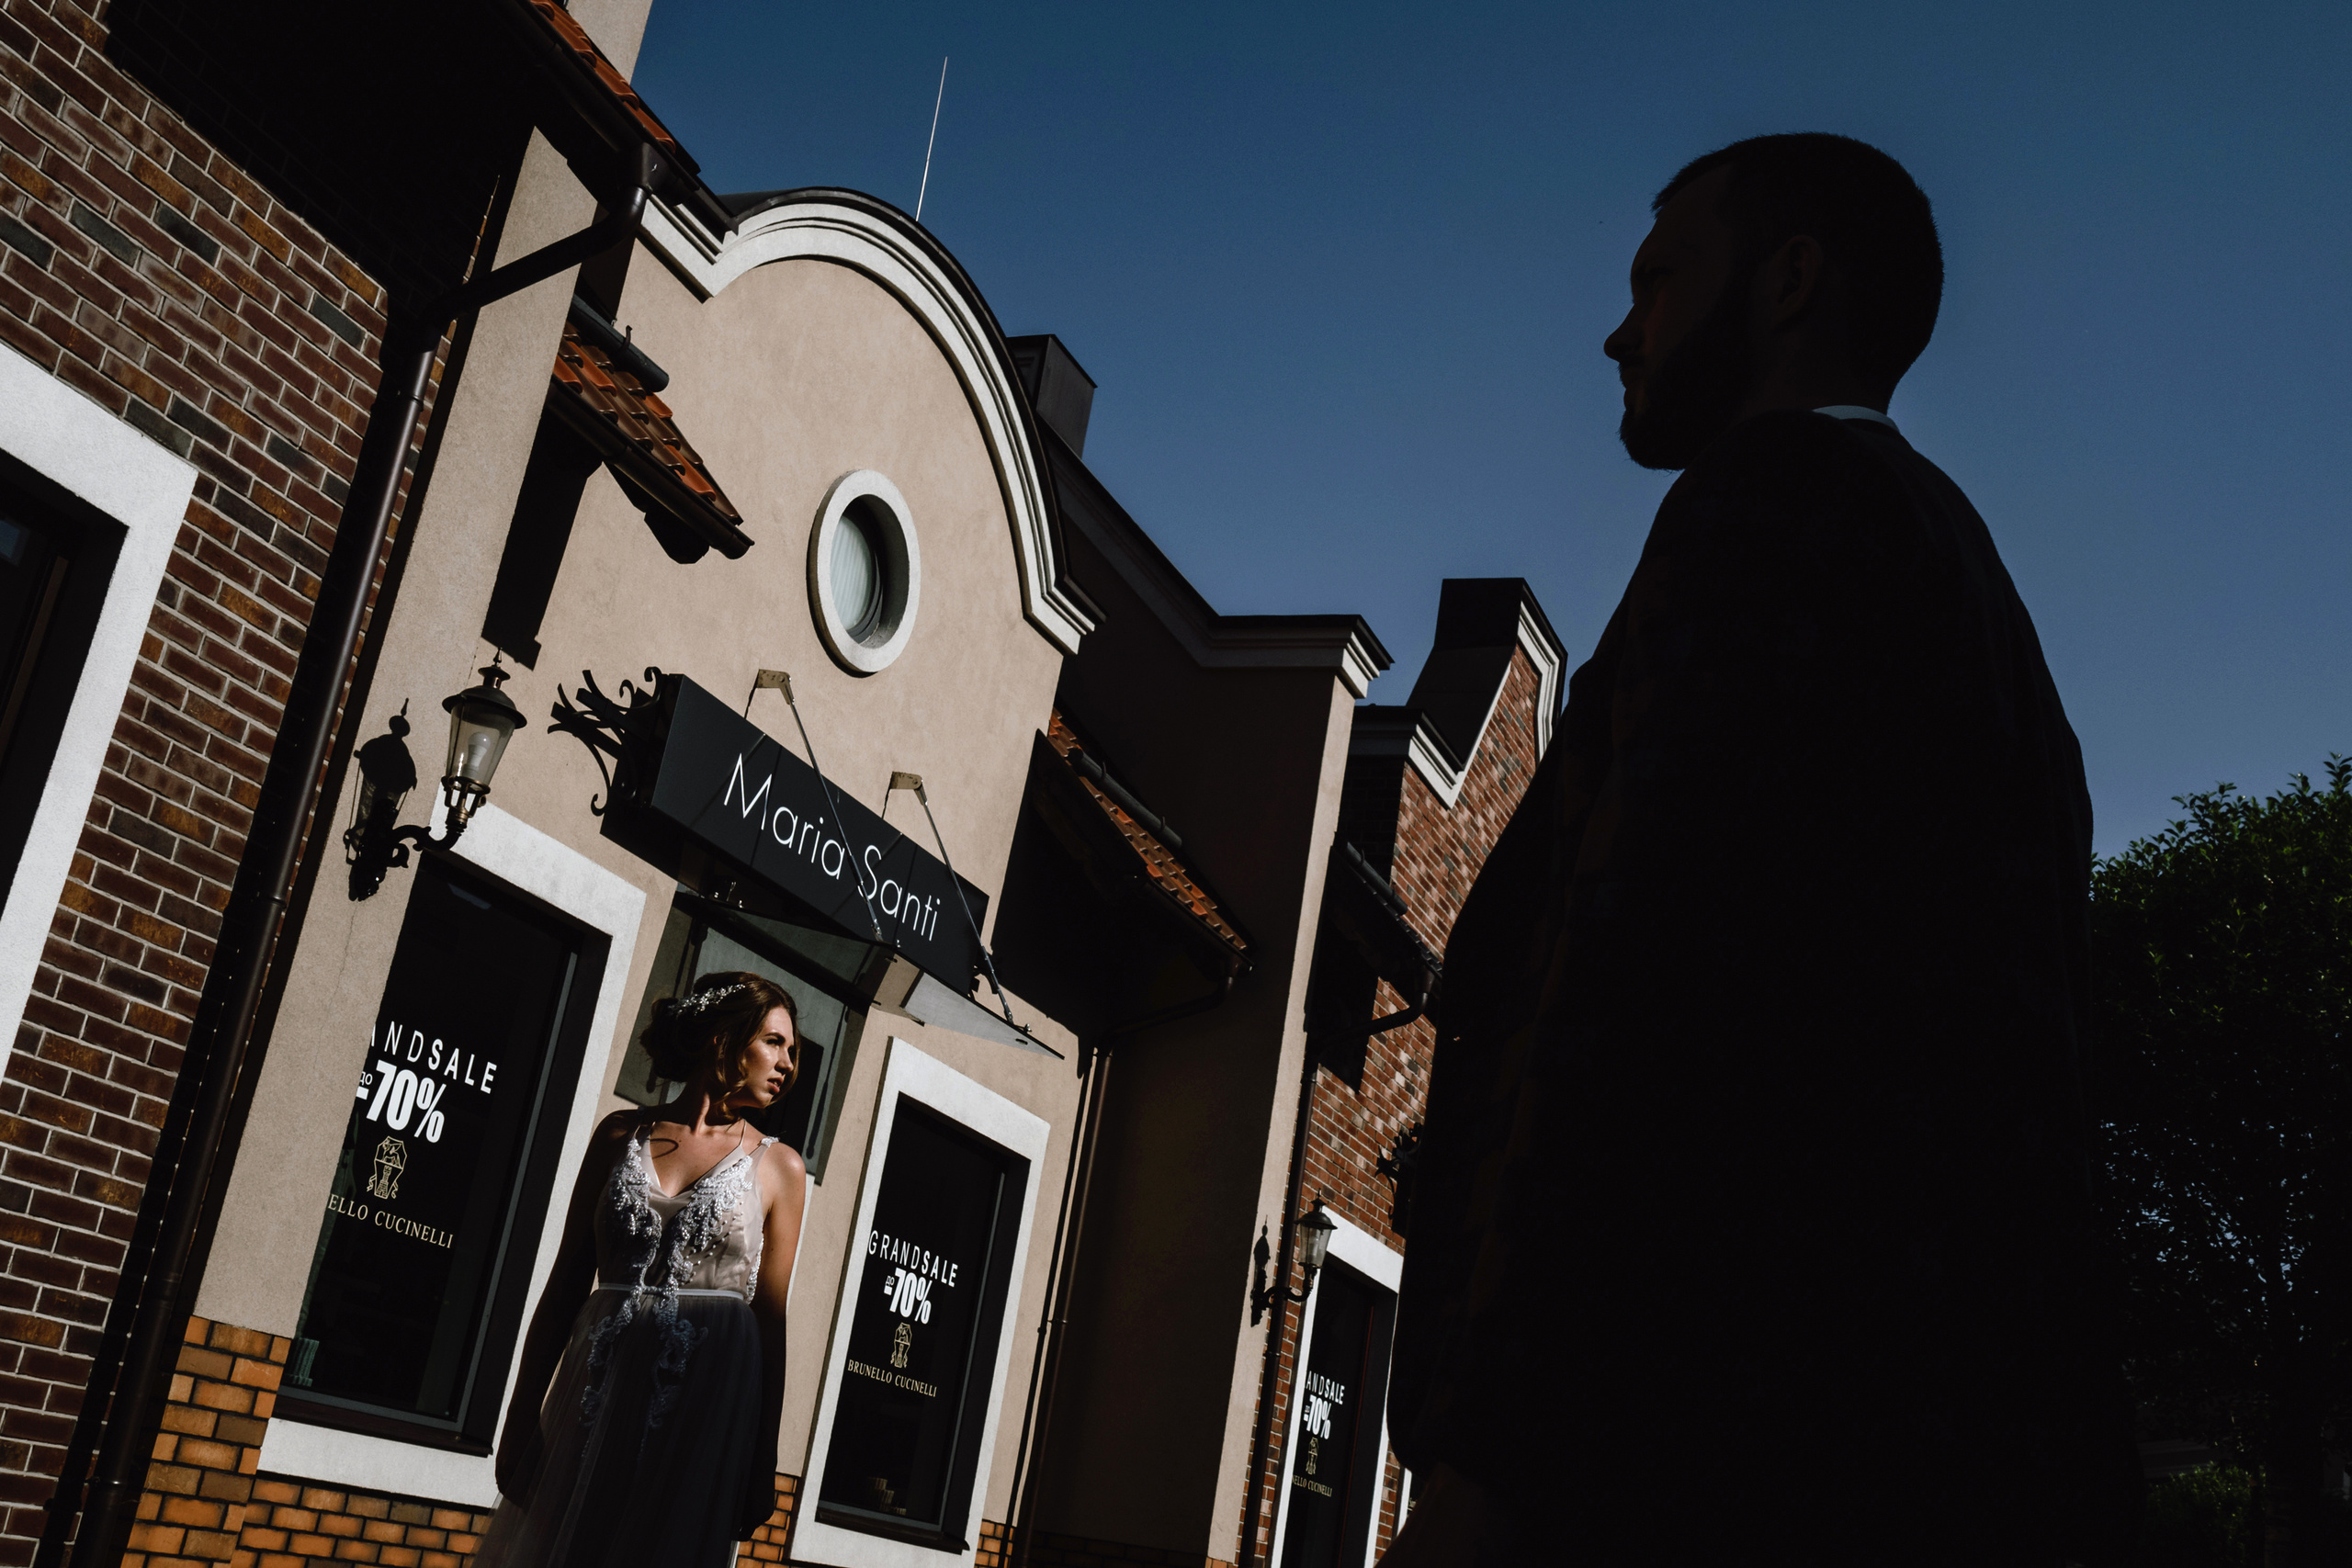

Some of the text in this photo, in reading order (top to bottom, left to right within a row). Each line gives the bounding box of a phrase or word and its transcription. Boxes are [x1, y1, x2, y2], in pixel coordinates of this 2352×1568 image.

[723, 752, 942, 942] Maria Santi
[374, 1210, 454, 1249] CUCINELLI
[868, 1230, 958, 1288] GRANDSALE
[847, 1359, 937, 1398] BRUNELLO CUCINELLI
